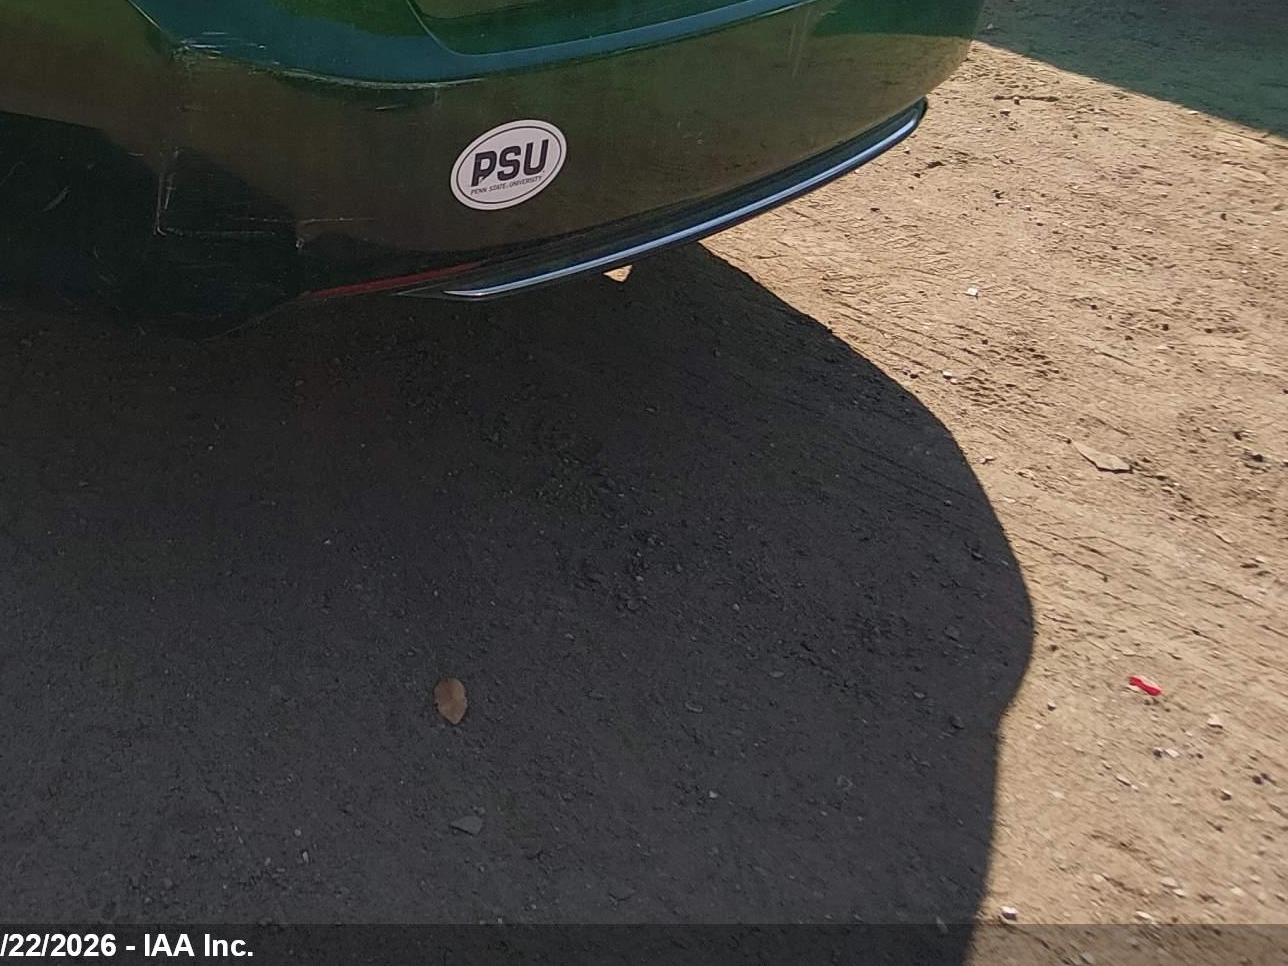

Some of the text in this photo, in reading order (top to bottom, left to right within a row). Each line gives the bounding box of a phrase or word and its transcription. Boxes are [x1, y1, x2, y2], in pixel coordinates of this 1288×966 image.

[471, 139, 549, 187] PSU
[470, 187, 487, 195] PENN
[509, 176, 542, 188] UNIVERSITY
